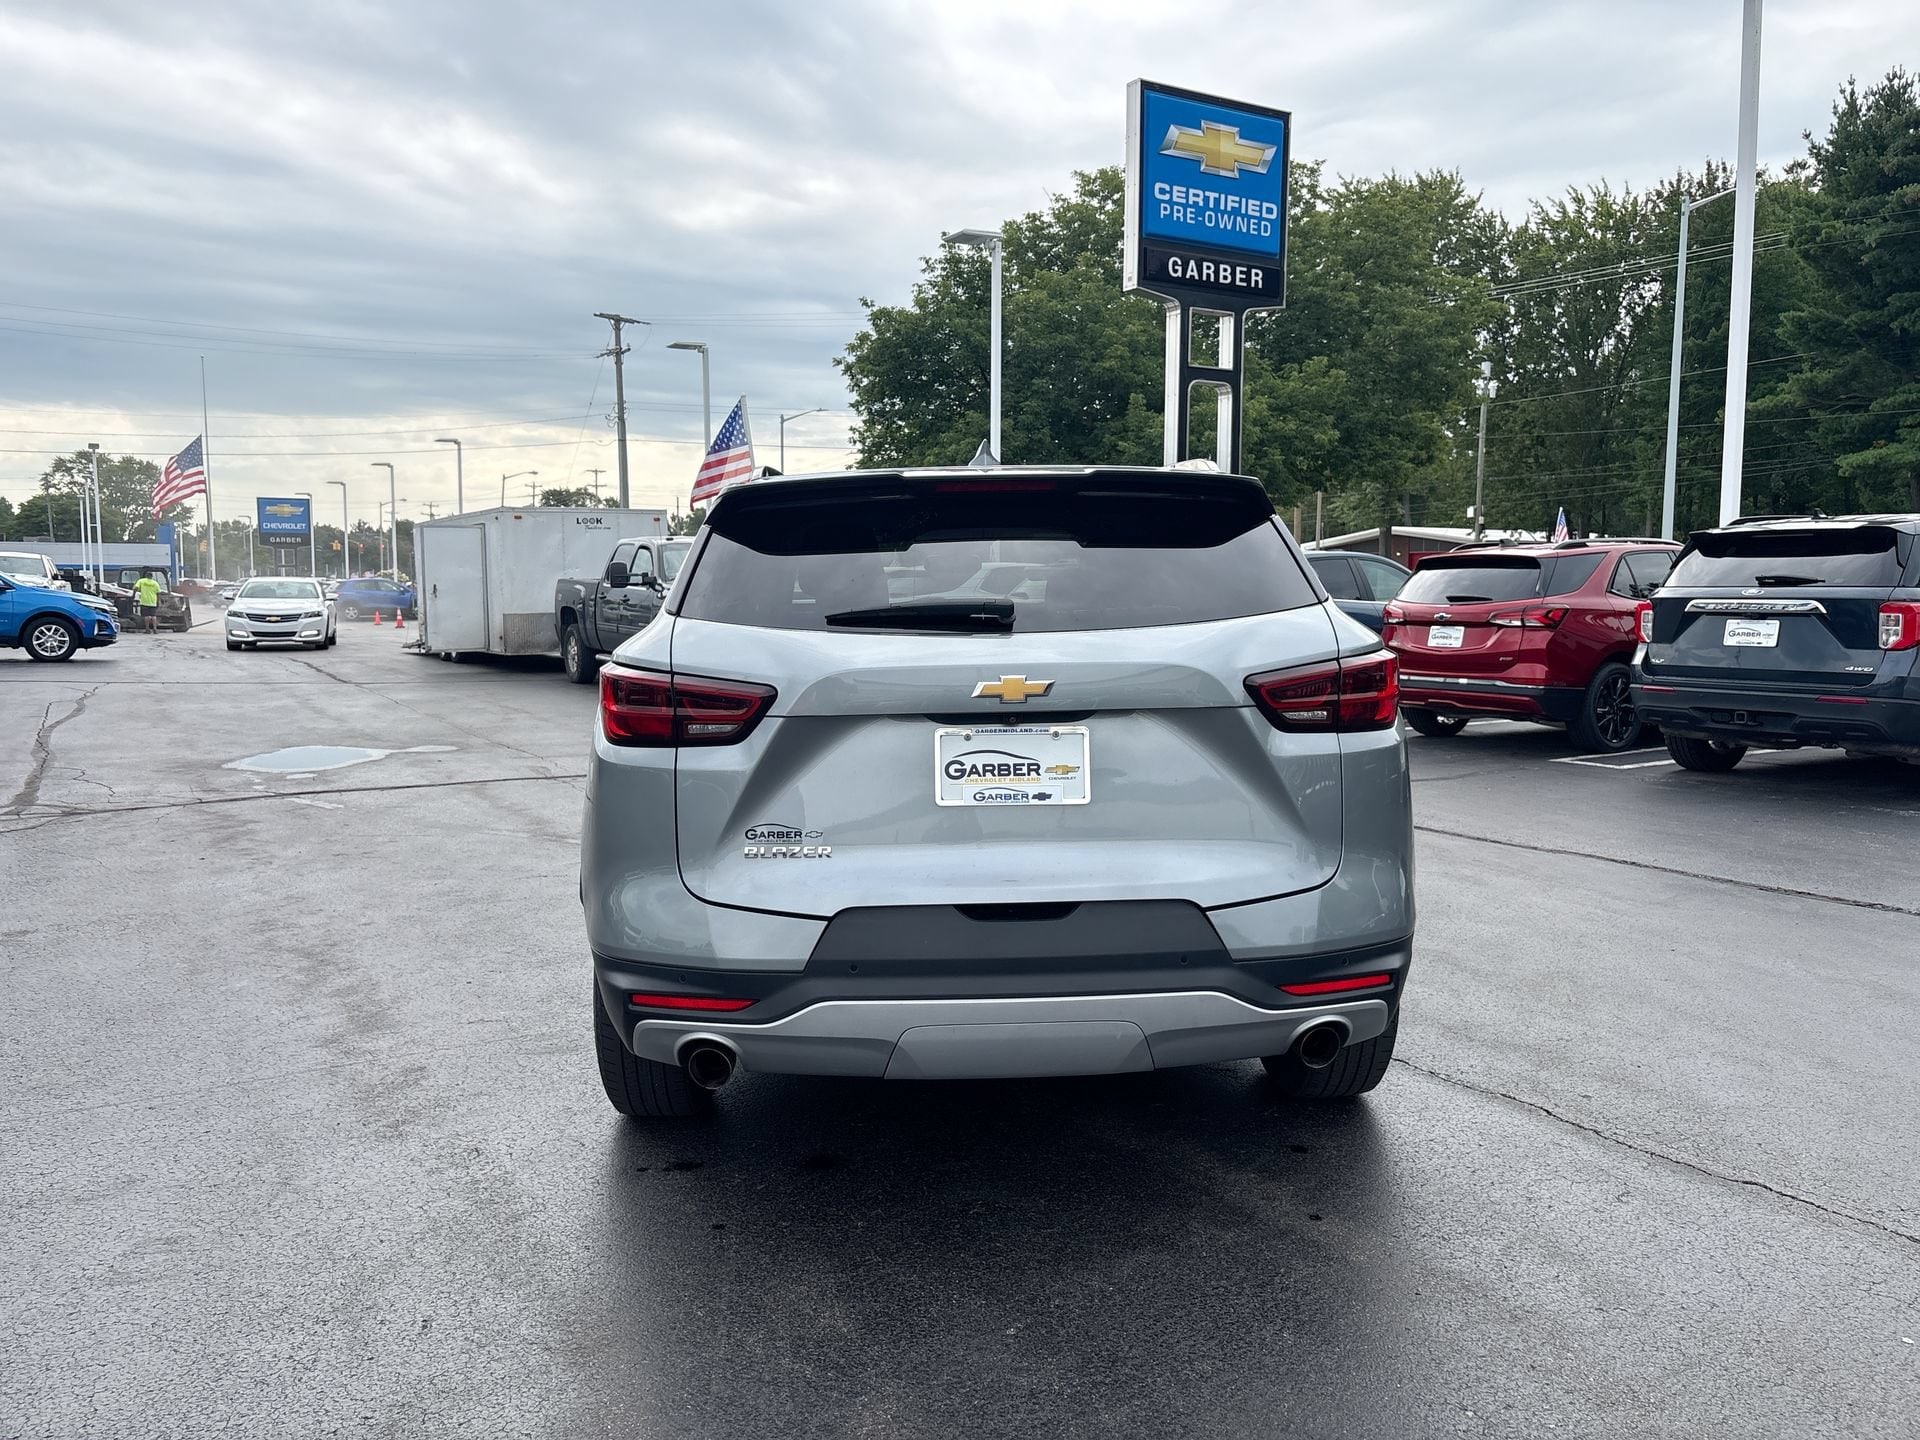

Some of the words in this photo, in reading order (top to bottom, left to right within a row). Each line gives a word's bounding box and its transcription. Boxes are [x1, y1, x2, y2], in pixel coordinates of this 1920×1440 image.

[1154, 182, 1278, 220] CERTIFIED
[1160, 203, 1271, 237] PRE-OWNED
[1168, 256, 1263, 289] GARBER
[262, 522, 306, 530] CHEVROLET
[576, 517, 603, 525] LOOK
[1705, 602, 1798, 611] EXPLORER
[1728, 630, 1761, 638] GARBER
[944, 759, 1042, 780] GARBER
[973, 791, 1029, 802] GARBER
[744, 829, 803, 841] GARBER
[744, 846, 833, 859] BLAZER
